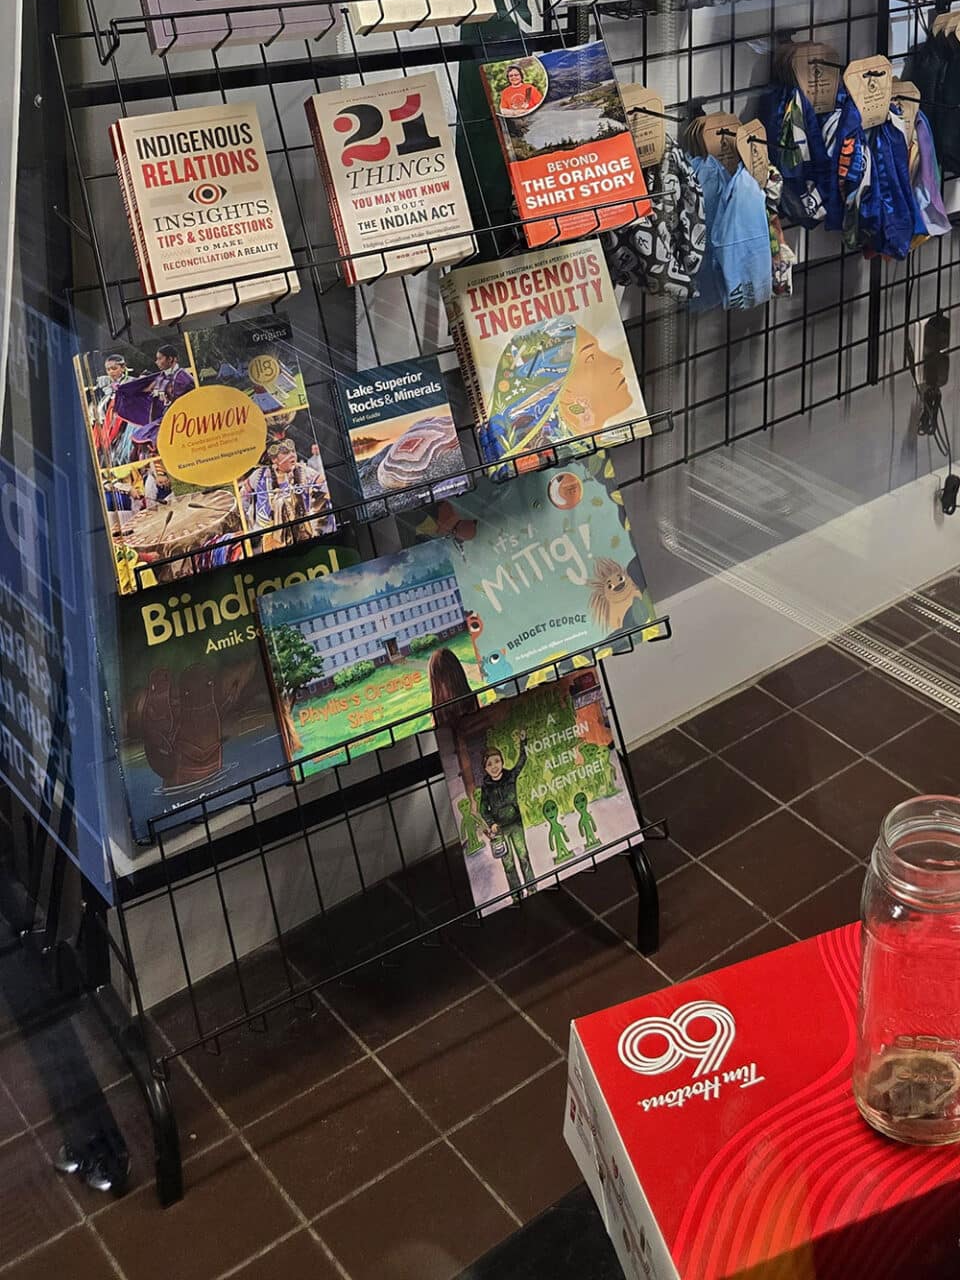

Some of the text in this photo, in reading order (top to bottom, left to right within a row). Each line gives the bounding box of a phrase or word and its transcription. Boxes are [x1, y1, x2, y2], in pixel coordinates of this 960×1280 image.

[136, 122, 253, 160] INDIGENOUS
[333, 93, 441, 167] 21
[142, 148, 259, 188] RELATIONS
[345, 153, 446, 190] THINGS
[521, 157, 632, 193] THE ORANGE
[547, 152, 598, 173] BEYOND
[352, 181, 450, 210] YOU MAY NOT KNOW
[525, 171, 635, 210] SHIRT STORY
[358, 203, 456, 231] THE INDIAN ACT
[385, 199, 425, 214] ABOUT
[157, 217, 274, 249] TIPS & SUGGESTIONS
[195, 239, 244, 253] TO MAKE
[163, 242, 279, 271] RECONCILIATION A REALITY
[466, 254, 601, 312] INDIGENOUS
[475, 278, 603, 340] INGENUITY
[252, 327, 287, 342] Origins
[346, 372, 423, 400] Lake Superior
[348, 382, 442, 415] Rocks & Minerals
[205, 628, 244, 655] Amik
[507, 622, 547, 650] BRIDGET
[549, 614, 587, 628] GEORGE
[364, 671, 421, 701] Orange
[348, 704, 384, 729] Shirt
[547, 713, 556, 726] A
[524, 721, 590, 757] NORTHERN
[544, 747, 577, 771] ALIEN
[722, 1062, 765, 1089] Tim
